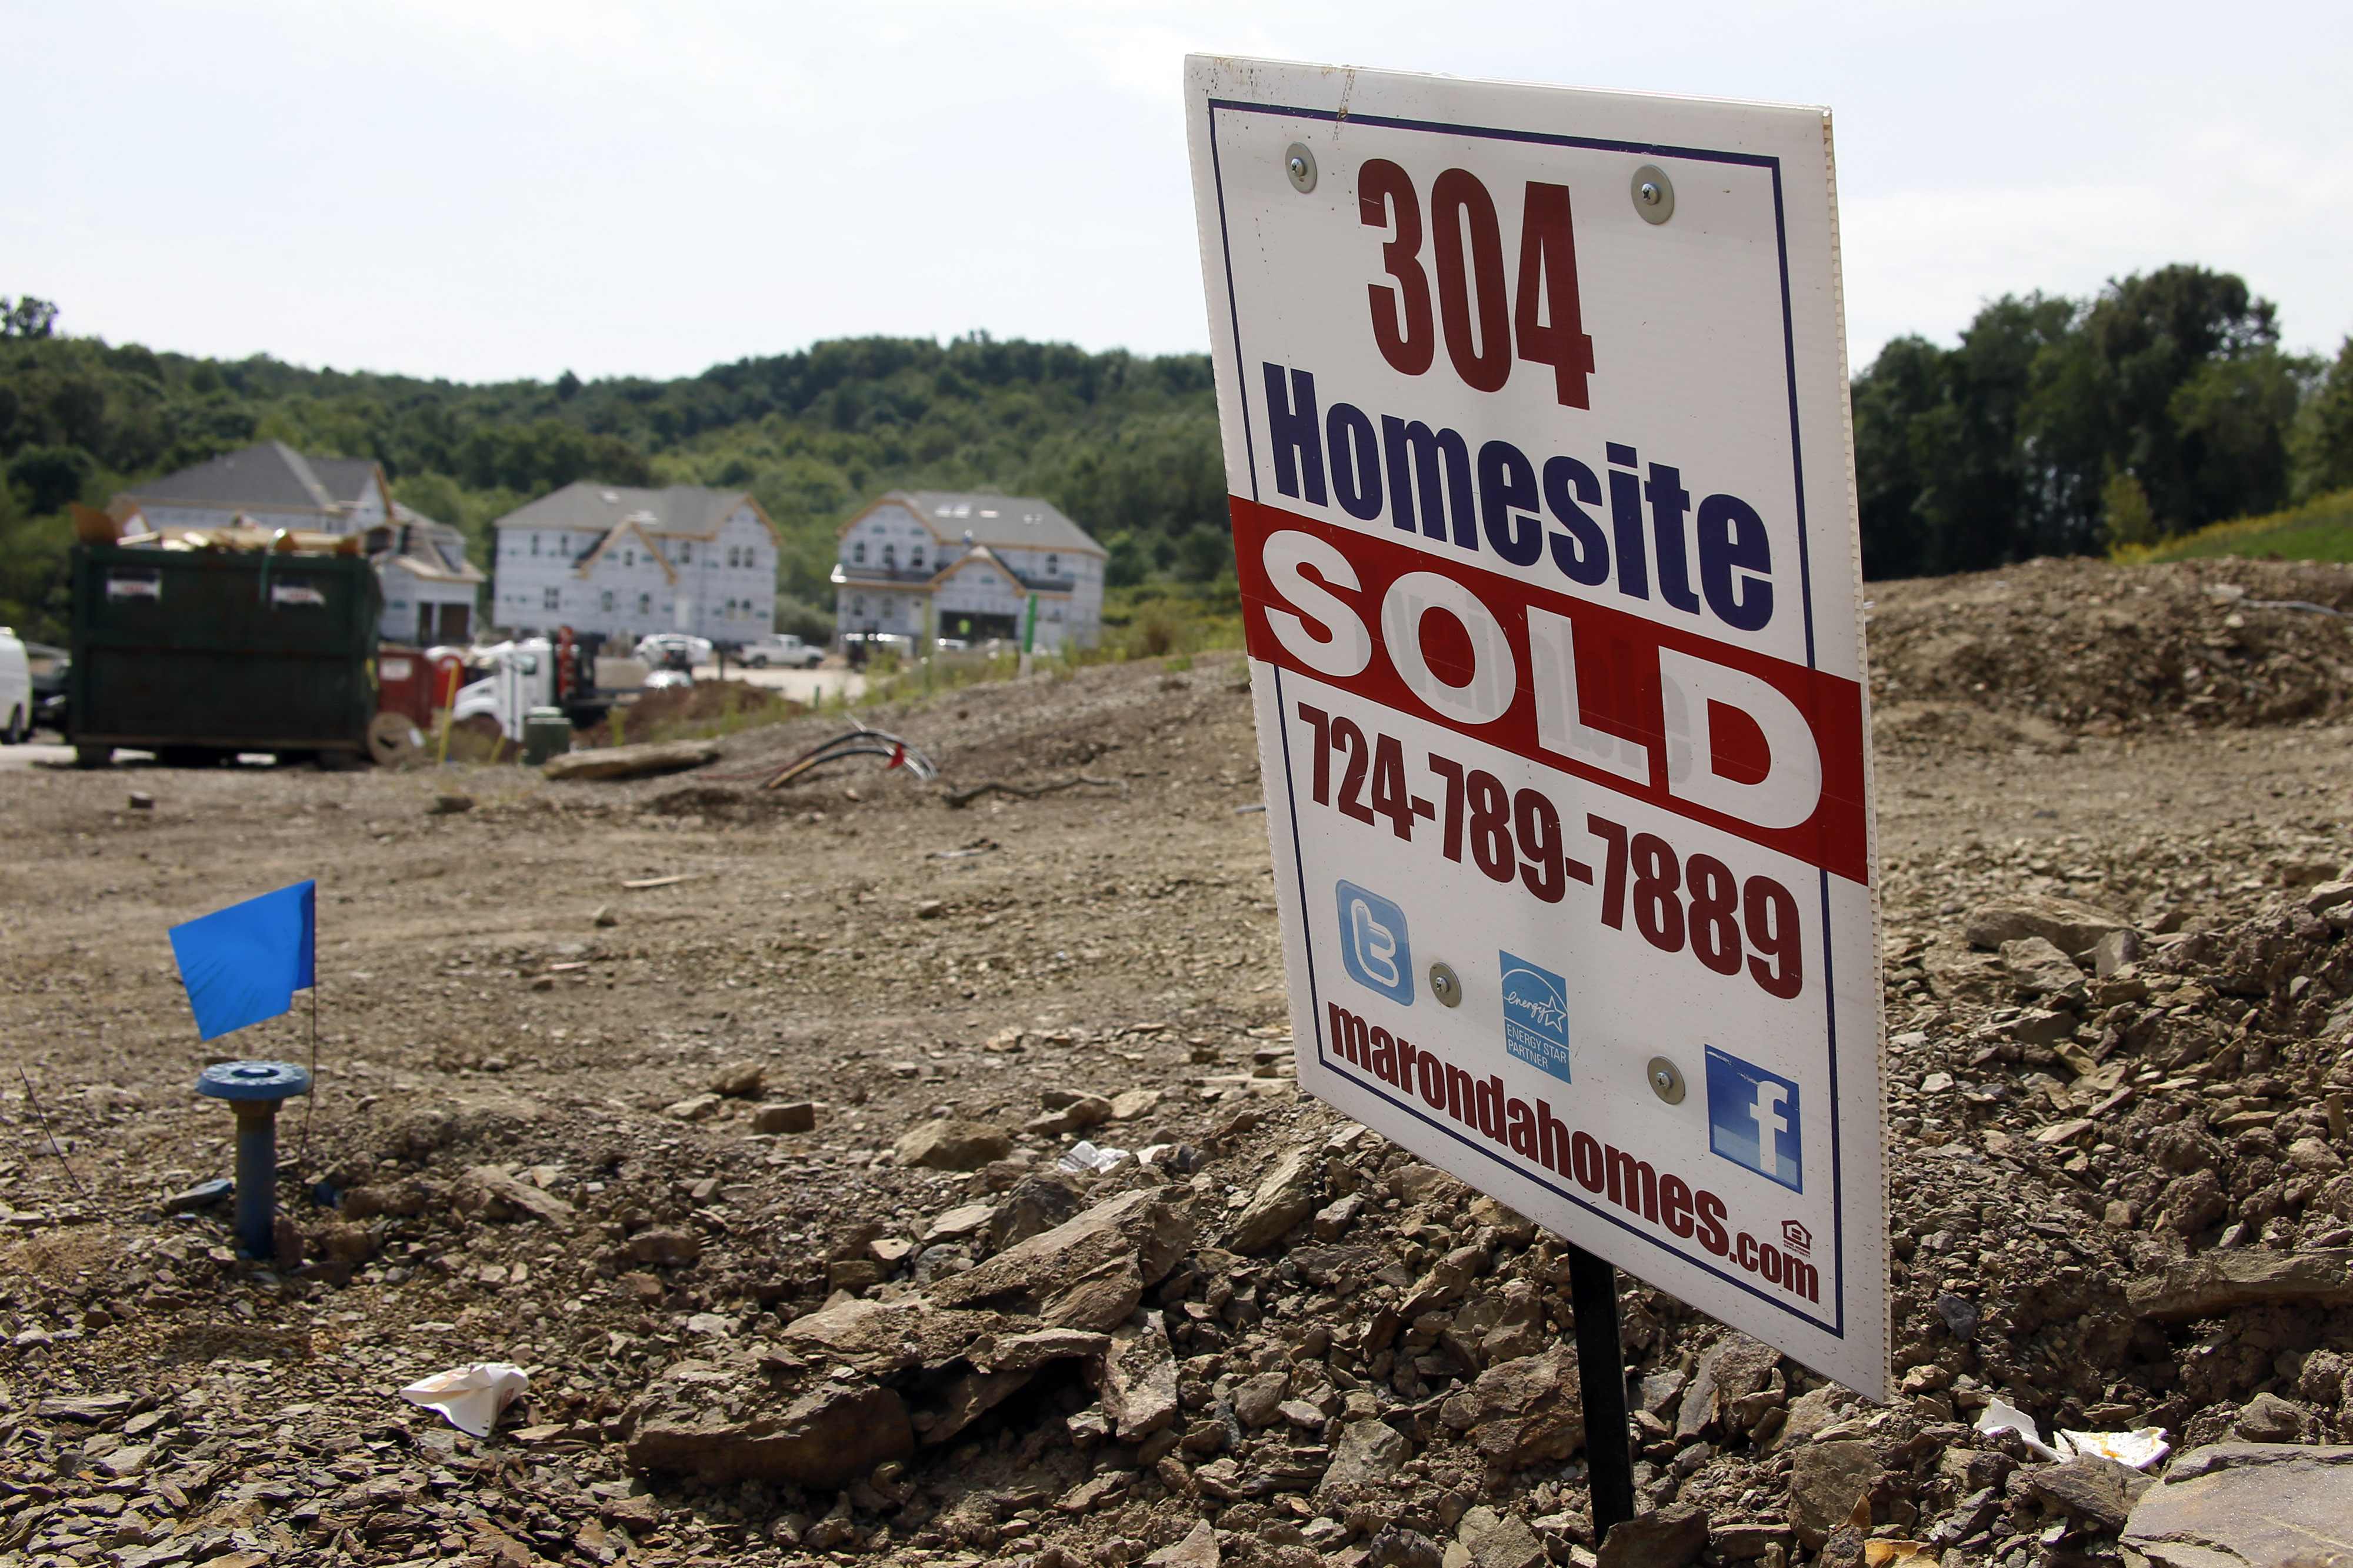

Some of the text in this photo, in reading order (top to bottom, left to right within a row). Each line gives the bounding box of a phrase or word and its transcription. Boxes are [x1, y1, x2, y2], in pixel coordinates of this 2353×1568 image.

[1358, 159, 1595, 411] 304
[1262, 362, 1773, 631] Homesite
[1263, 530, 1822, 829] SOLD
[1298, 701, 1802, 999] 724-789-7889
[1504, 991, 1547, 1023] energy
[1507, 1024, 1567, 1064] ENERGY STAR
[1508, 1039, 1549, 1069] PARTNER
[1328, 1002, 1819, 1305] marondahomes.com
[1749, 1080, 1788, 1176] f
[1783, 1243, 1810, 1259] OPPORTUNITY
